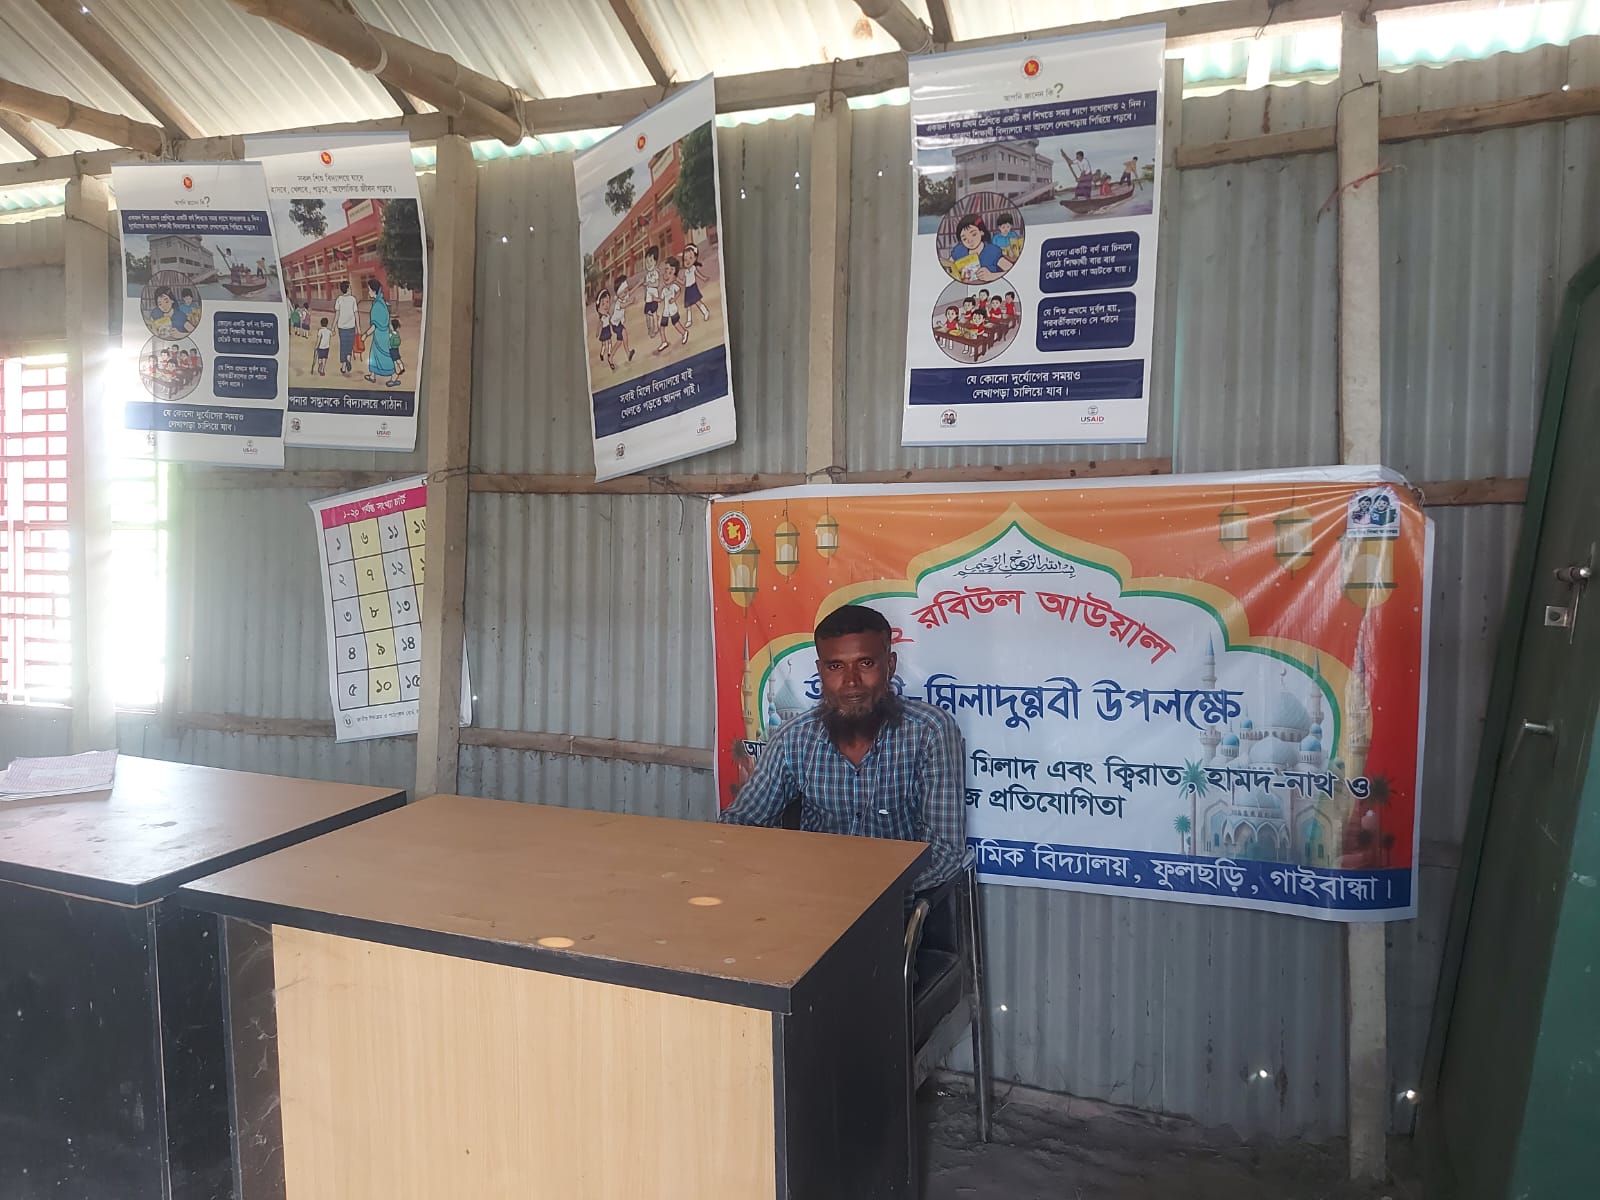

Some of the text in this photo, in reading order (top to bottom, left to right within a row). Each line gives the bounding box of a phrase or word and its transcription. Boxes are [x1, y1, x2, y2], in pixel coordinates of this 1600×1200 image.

[1046, 242, 1132, 258] কোনো একটি বর্ণ না চিনলে
[1046, 259, 1062, 269] পাঠে
[1089, 257, 1101, 265] বার
[1090, 266, 1112, 275] আটকে
[1043, 308, 1051, 316] যে
[1053, 306, 1067, 316] শিশু
[1068, 306, 1087, 314] প্রথমে
[1089, 303, 1105, 315] দুর্বল
[1089, 317, 1098, 325] সে
[1042, 328, 1058, 339] দুর্বল
[619, 367, 694, 404] সবাই মিলে বিদ্যালয়ে যাই
[966, 370, 1081, 386] যে কোনো দুর্যোগের সময়ও
[288, 396, 308, 407] পনার
[310, 396, 341, 408] সন্তানকে
[343, 394, 379, 410] বিদ্যালয়ে
[972, 387, 1010, 400] লেখাপড়া
[1012, 385, 1043, 398] চালিয়ে
[621, 403, 642, 419] খেলতে
[642, 396, 662, 412] পড়তে
[336, 537, 342, 550] ১
[360, 532, 369, 545] ৬
[387, 525, 399, 540] ১১
[338, 573, 347, 587] ২
[366, 568, 375, 581] ৭
[391, 561, 407, 576] ১২
[343, 599, 411, 623] ৩ ৮ ১৩
[911, 585, 1177, 665] রবিউল আউয়াল
[348, 636, 416, 660] ৪ ৯ ১৪
[348, 683, 358, 697] ৫
[375, 679, 392, 694] ১০
[1092, 679, 1245, 731] উপলক্ষে
[969, 748, 1040, 781] মিলাদ
[1047, 760, 1097, 785] এবং
[1203, 764, 1339, 800] হামদ-নাথ
[1345, 775, 1370, 799] ও
[988, 783, 1128, 819] প্রতিযোগিতা
[976, 838, 1027, 868] মিক
